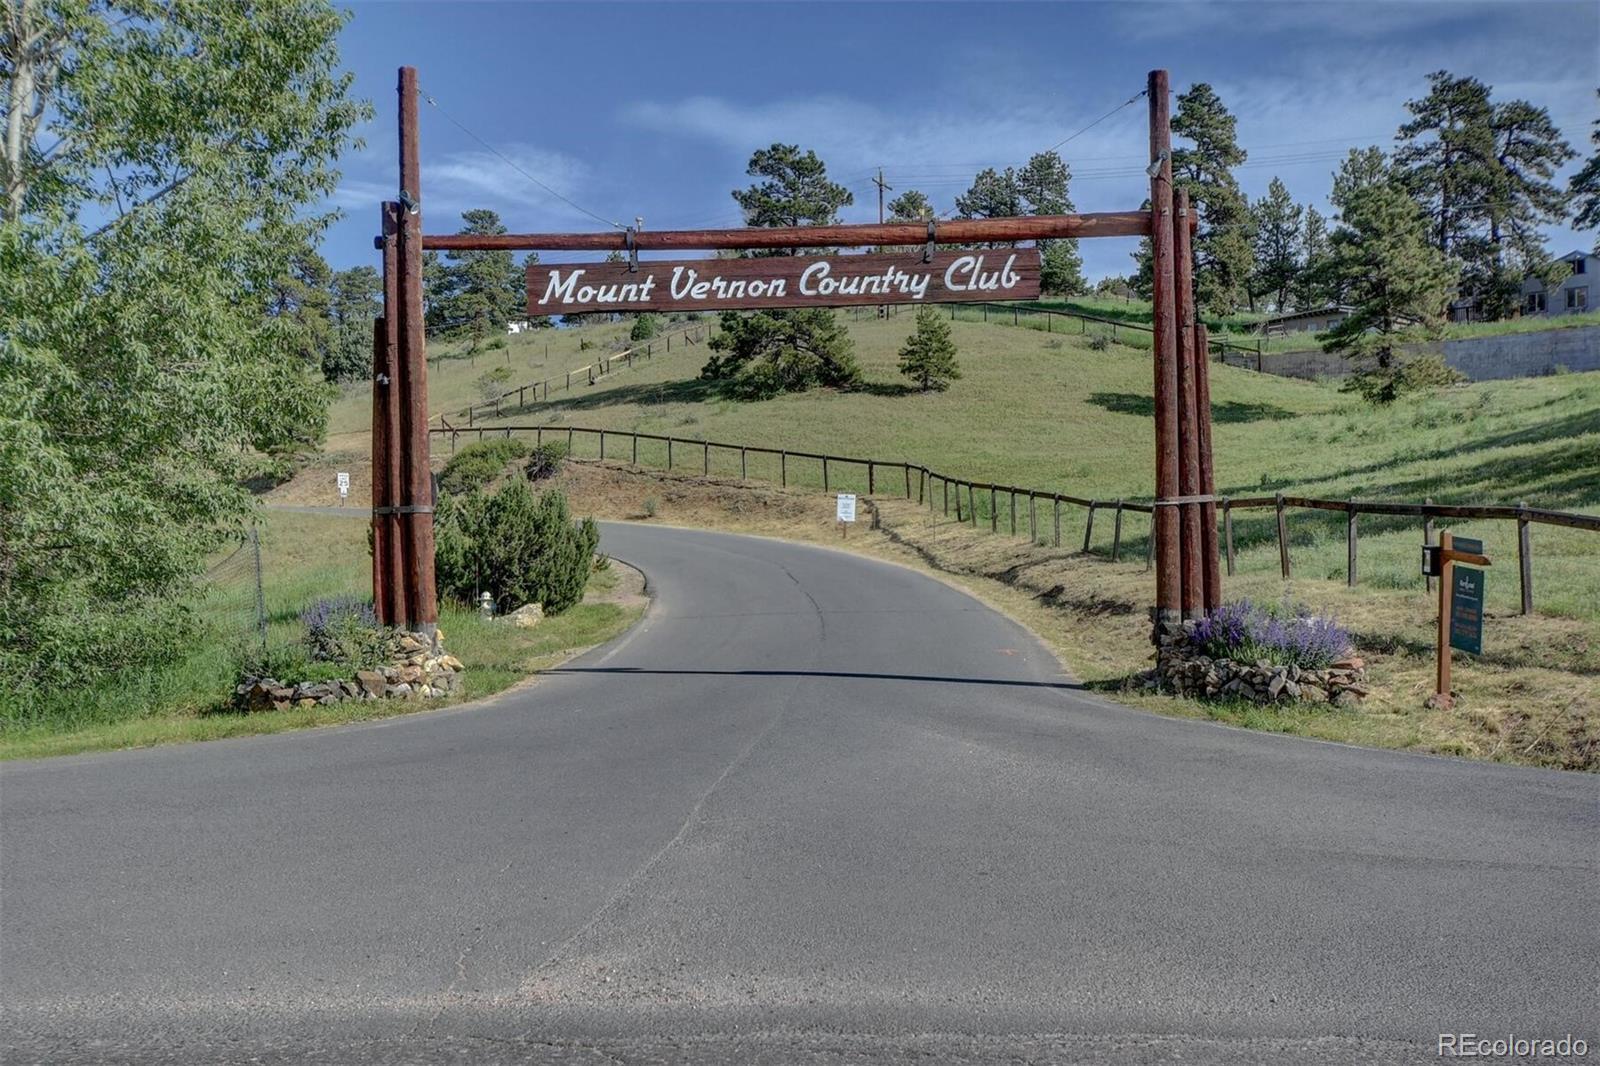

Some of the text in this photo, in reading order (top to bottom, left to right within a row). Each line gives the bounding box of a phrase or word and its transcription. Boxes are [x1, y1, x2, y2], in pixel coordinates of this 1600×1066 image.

[538, 254, 1021, 304] Mount Vernon Country Club
